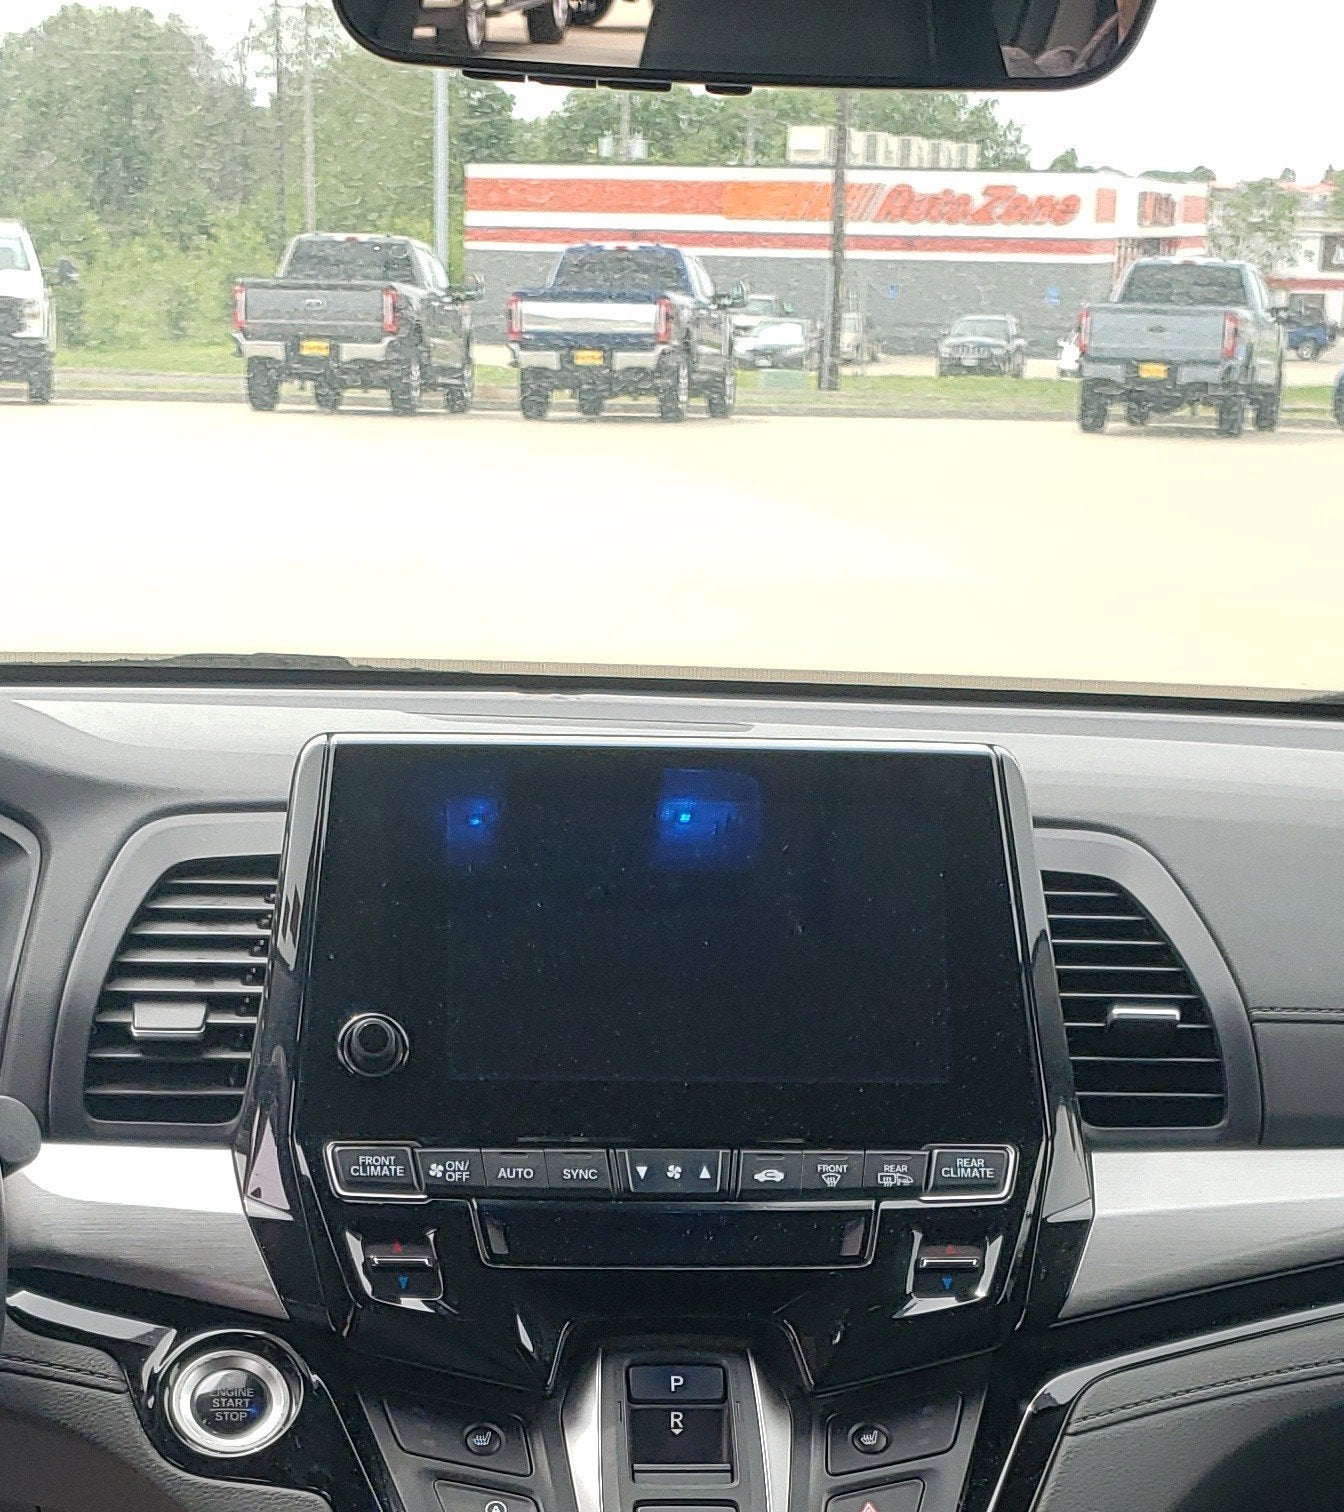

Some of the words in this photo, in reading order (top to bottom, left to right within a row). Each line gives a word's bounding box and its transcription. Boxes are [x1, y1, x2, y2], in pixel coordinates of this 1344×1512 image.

[873, 183, 1080, 225] AutoZone
[358, 1155, 396, 1166] FRONT
[445, 1160, 470, 1172] ON/
[956, 1158, 985, 1168] REAR
[350, 1166, 405, 1177] CLIMATE
[497, 1168, 534, 1180] AUTO
[562, 1168, 598, 1180] SYNC
[817, 1164, 847, 1173] FRONT
[883, 1164, 908, 1173] REAR
[941, 1167, 995, 1178] CLIMATE
[445, 1171, 470, 1183] OFF
[669, 1375, 684, 1392] P
[212, 1398, 251, 1408] START
[215, 1411, 248, 1421] STOP
[669, 1411, 684, 1428] R
